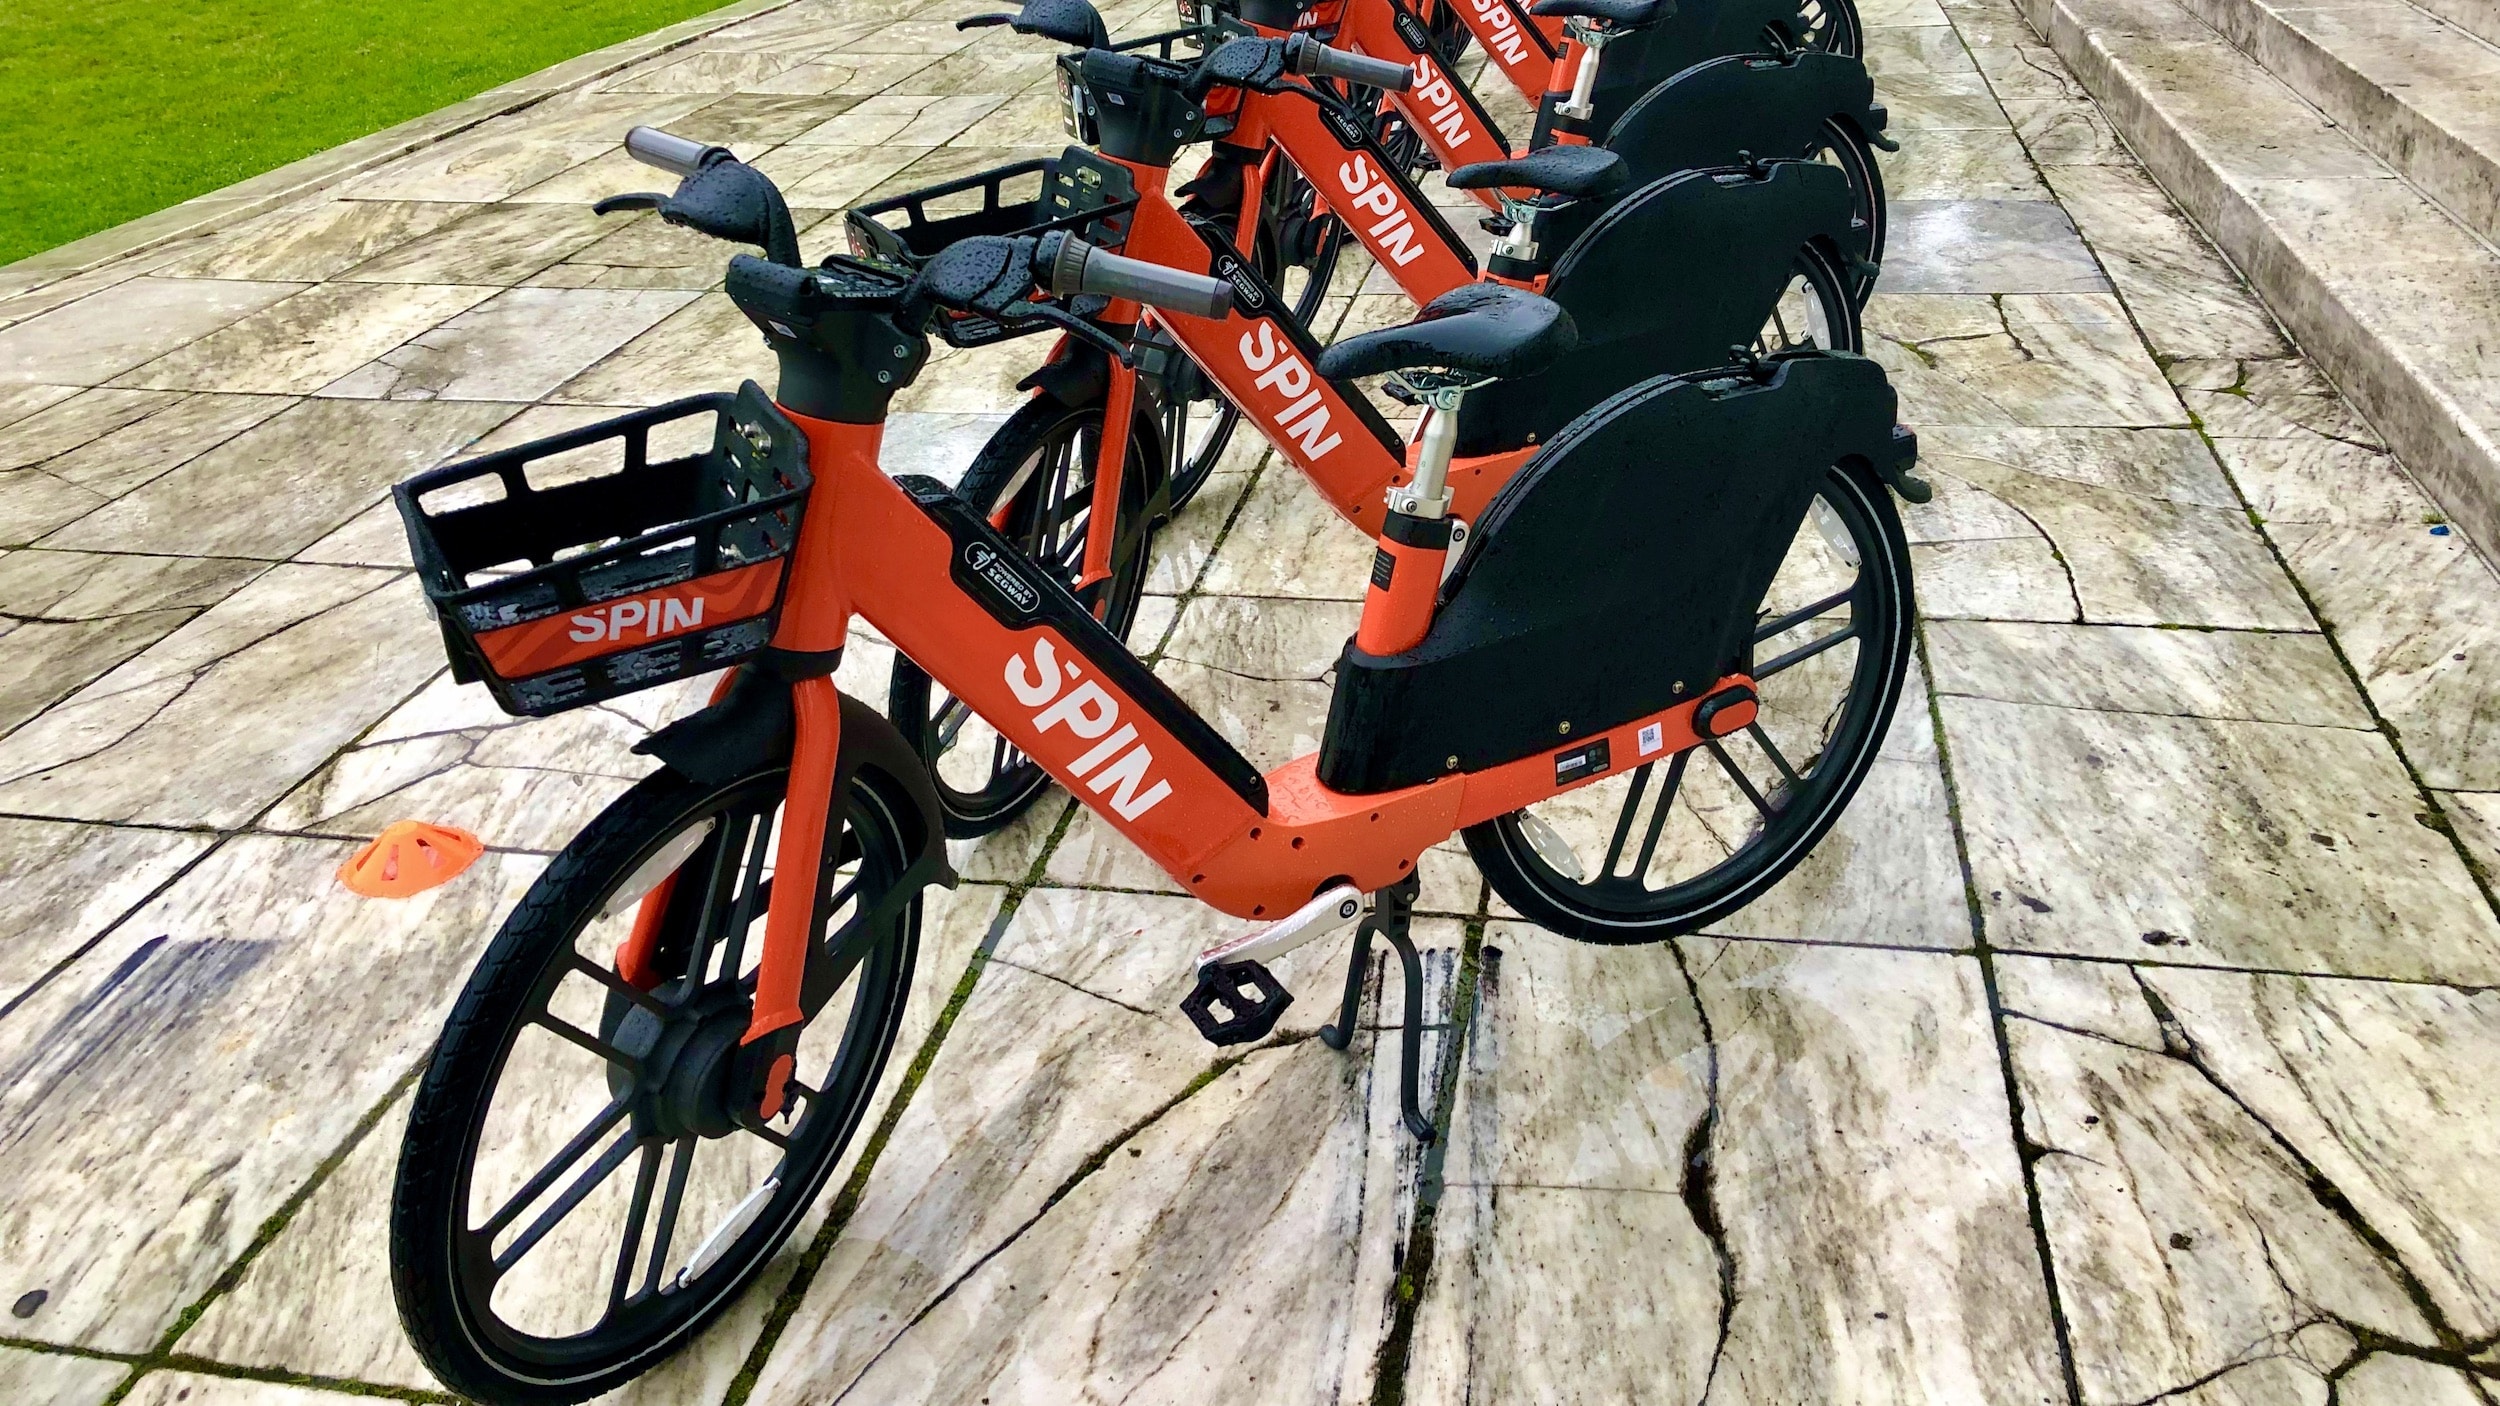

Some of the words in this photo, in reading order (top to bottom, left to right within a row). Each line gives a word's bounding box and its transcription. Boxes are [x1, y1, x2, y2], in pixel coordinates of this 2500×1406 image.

[1411, 55, 1472, 149] SPIN
[1338, 154, 1425, 267] SPIN
[1239, 320, 1343, 462] SPIN
[569, 597, 704, 643] SPIN
[986, 567, 1029, 605] SEGWAY
[993, 562, 1025, 591] POWERED
[1022, 589, 1034, 599] BY
[1004, 636, 1173, 823] SPIN
